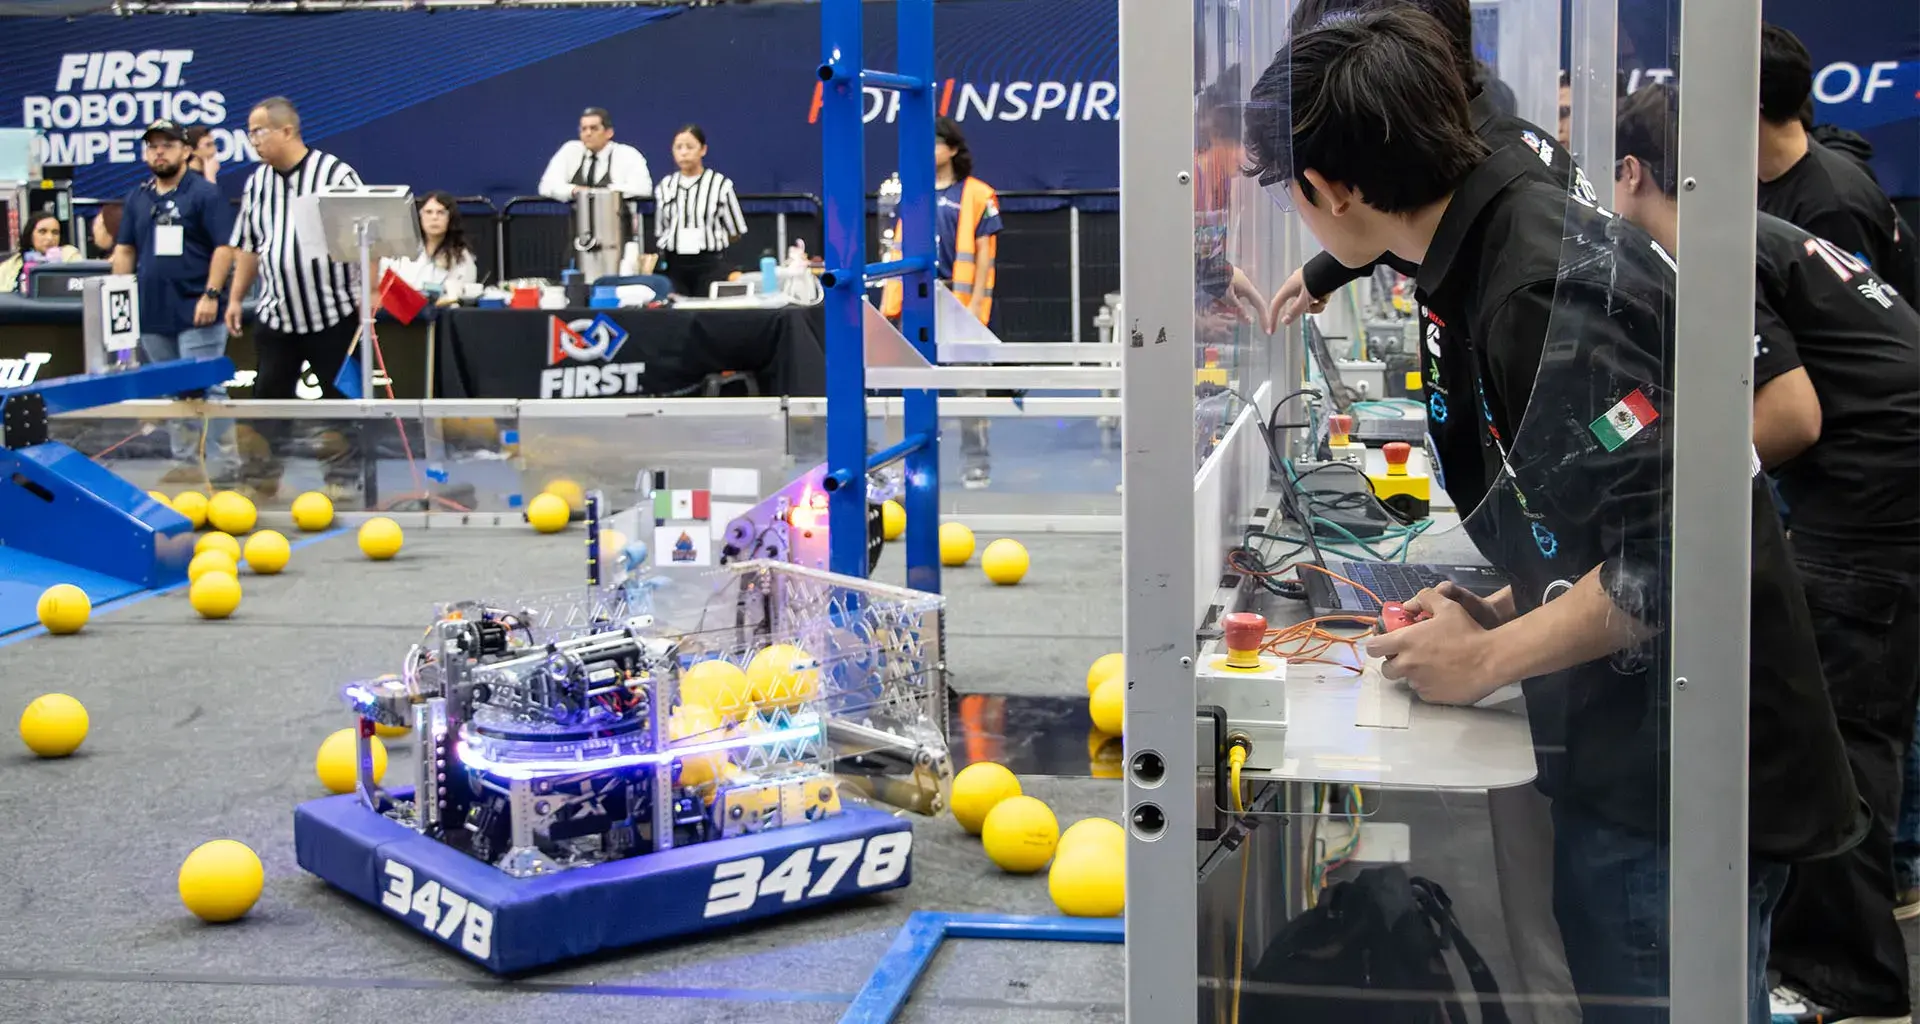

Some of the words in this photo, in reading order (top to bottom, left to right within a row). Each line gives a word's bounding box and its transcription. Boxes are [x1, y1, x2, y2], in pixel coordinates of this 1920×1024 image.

[55, 50, 194, 92] FIRST
[938, 78, 1120, 122] INSPIR
[1812, 61, 1898, 104] OF
[23, 91, 227, 129] ROBOTICS
[540, 362, 645, 399] FIRST
[704, 831, 912, 918] 3478
[382, 858, 493, 960] 3478
